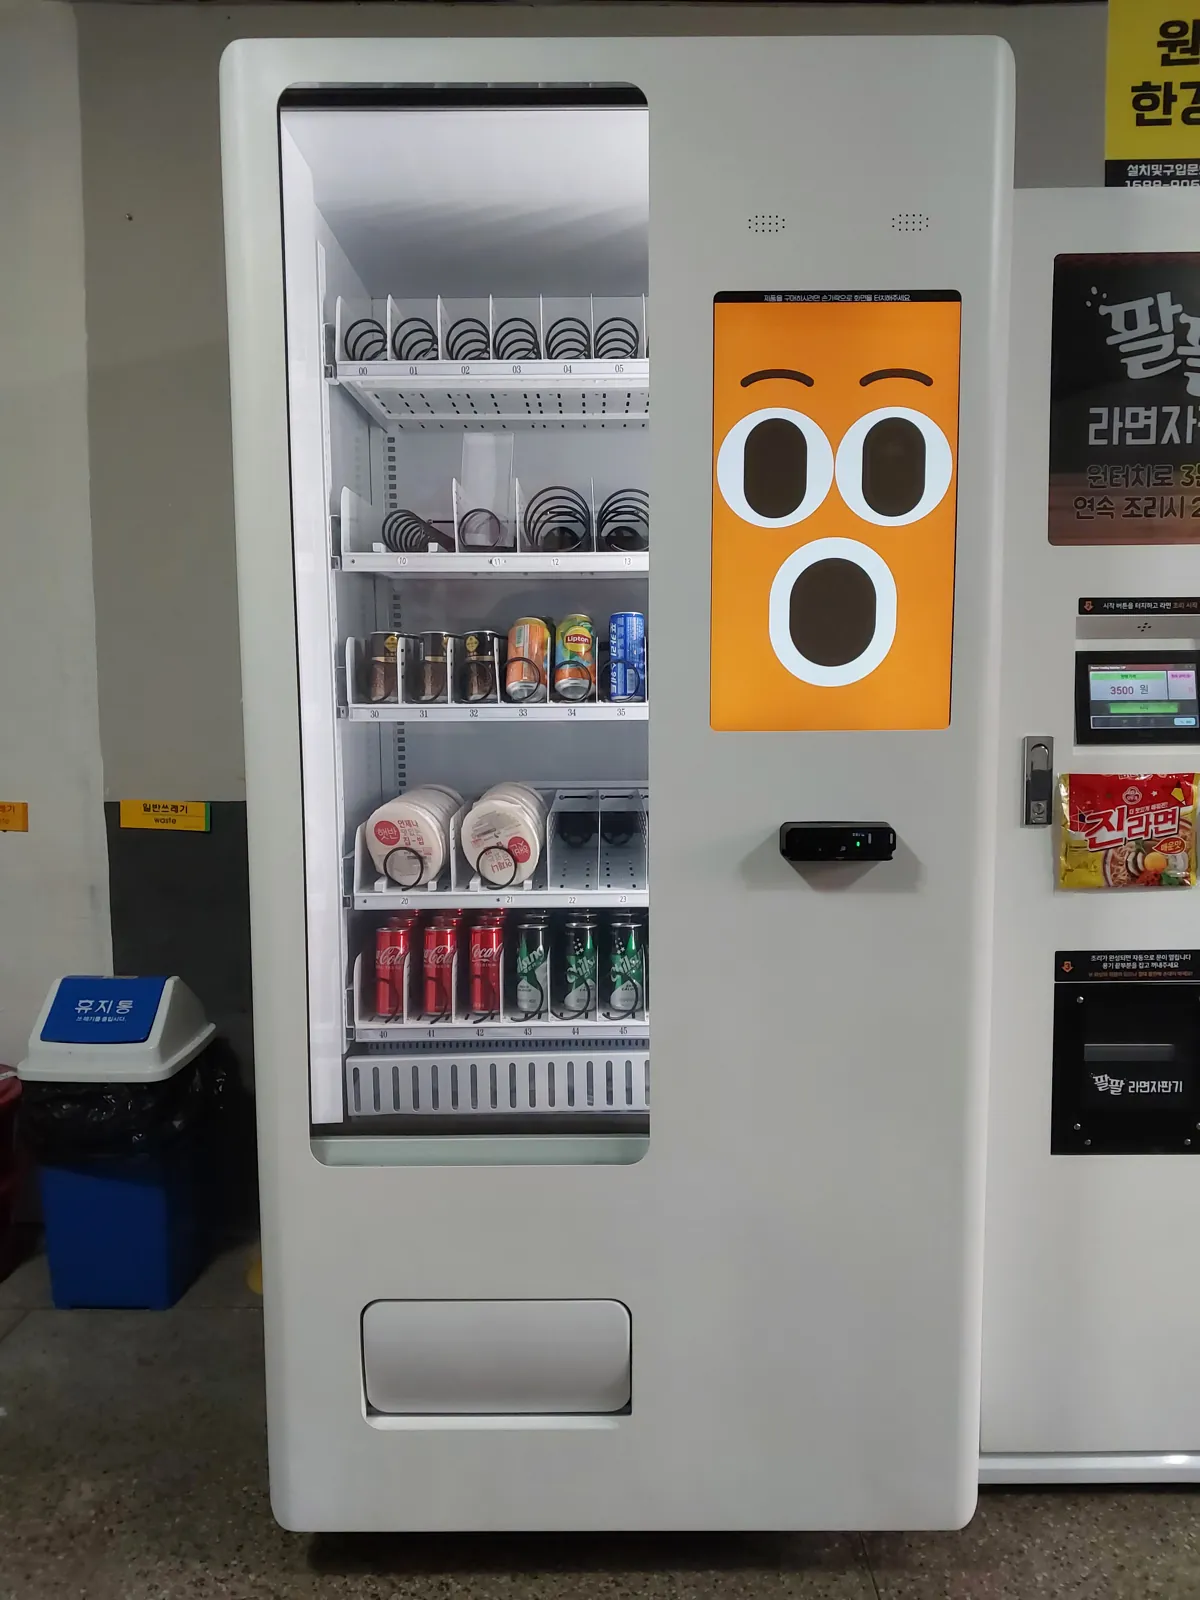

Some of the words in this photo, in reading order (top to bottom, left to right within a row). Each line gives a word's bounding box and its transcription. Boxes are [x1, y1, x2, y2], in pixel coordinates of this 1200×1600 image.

[1157, 19, 1200, 66] 원
[1127, 163, 1200, 177] 설치및구입문
[1098, 291, 1200, 397] 팔
[358, 366, 368, 375] 00
[409, 366, 418, 375] 01
[460, 365, 470, 375] 02
[512, 365, 522, 374] 03
[563, 364, 572, 374] 04
[614, 364, 624, 373] 05
[1088, 405, 1200, 446] 라면자
[1087, 464, 1174, 489] 원터치로
[1180, 464, 1200, 487] 3
[1073, 495, 1115, 520] 연속
[1121, 495, 1185, 519] 조리시
[398, 557, 407, 565] 10
[552, 558, 560, 566] 12
[566, 634, 589, 644] Lipton
[1110, 685, 1134, 695] 3500
[1140, 684, 1149, 695] 원
[370, 710, 379, 718] 30
[420, 710, 428, 718] 31
[469, 709, 478, 718] 32
[519, 708, 528, 717] 33
[567, 708, 576, 717] 34
[617, 708, 626, 716] 35
[142, 802, 188, 814] 일반쓰레기
[154, 817, 177, 825] waste
[397, 819, 419, 828] 언제나
[377, 827, 398, 841] 햇반
[1085, 805, 1179, 852] 진라면
[401, 897, 409, 905] 20
[506, 896, 513, 904] 21
[568, 896, 577, 904] 22
[619, 895, 627, 903] 23
[74, 999, 133, 1015] 휴지통
[379, 1030, 388, 1039] 40
[427, 1030, 435, 1038] 41
[475, 1029, 484, 1037] 42
[523, 1028, 532, 1036] 43
[571, 1027, 580, 1035] 44
[619, 1026, 628, 1035] 45
[1092, 1073, 1126, 1096] 팔팔
[1128, 1080, 1183, 1093] 라면자판기
